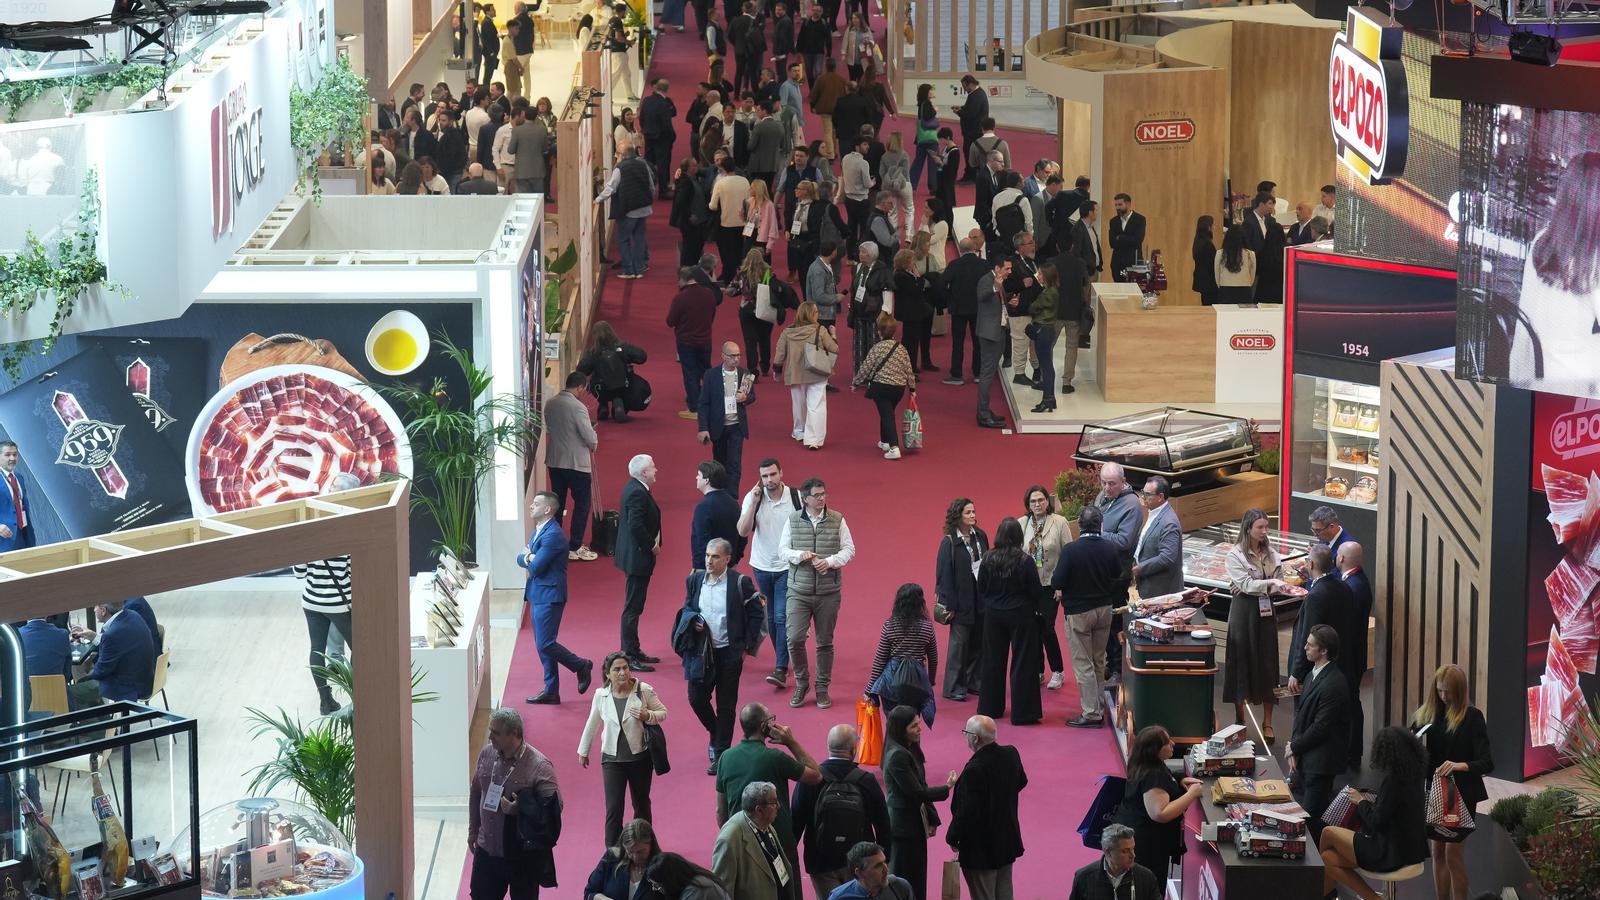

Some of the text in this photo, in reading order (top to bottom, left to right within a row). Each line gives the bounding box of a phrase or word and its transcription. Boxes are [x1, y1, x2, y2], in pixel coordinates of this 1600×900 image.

[1143, 124, 1186, 139] NOEL
[227, 104, 265, 232] JORGE
[1236, 338, 1269, 347] NOEL
[1342, 342, 1370, 357] 1954
